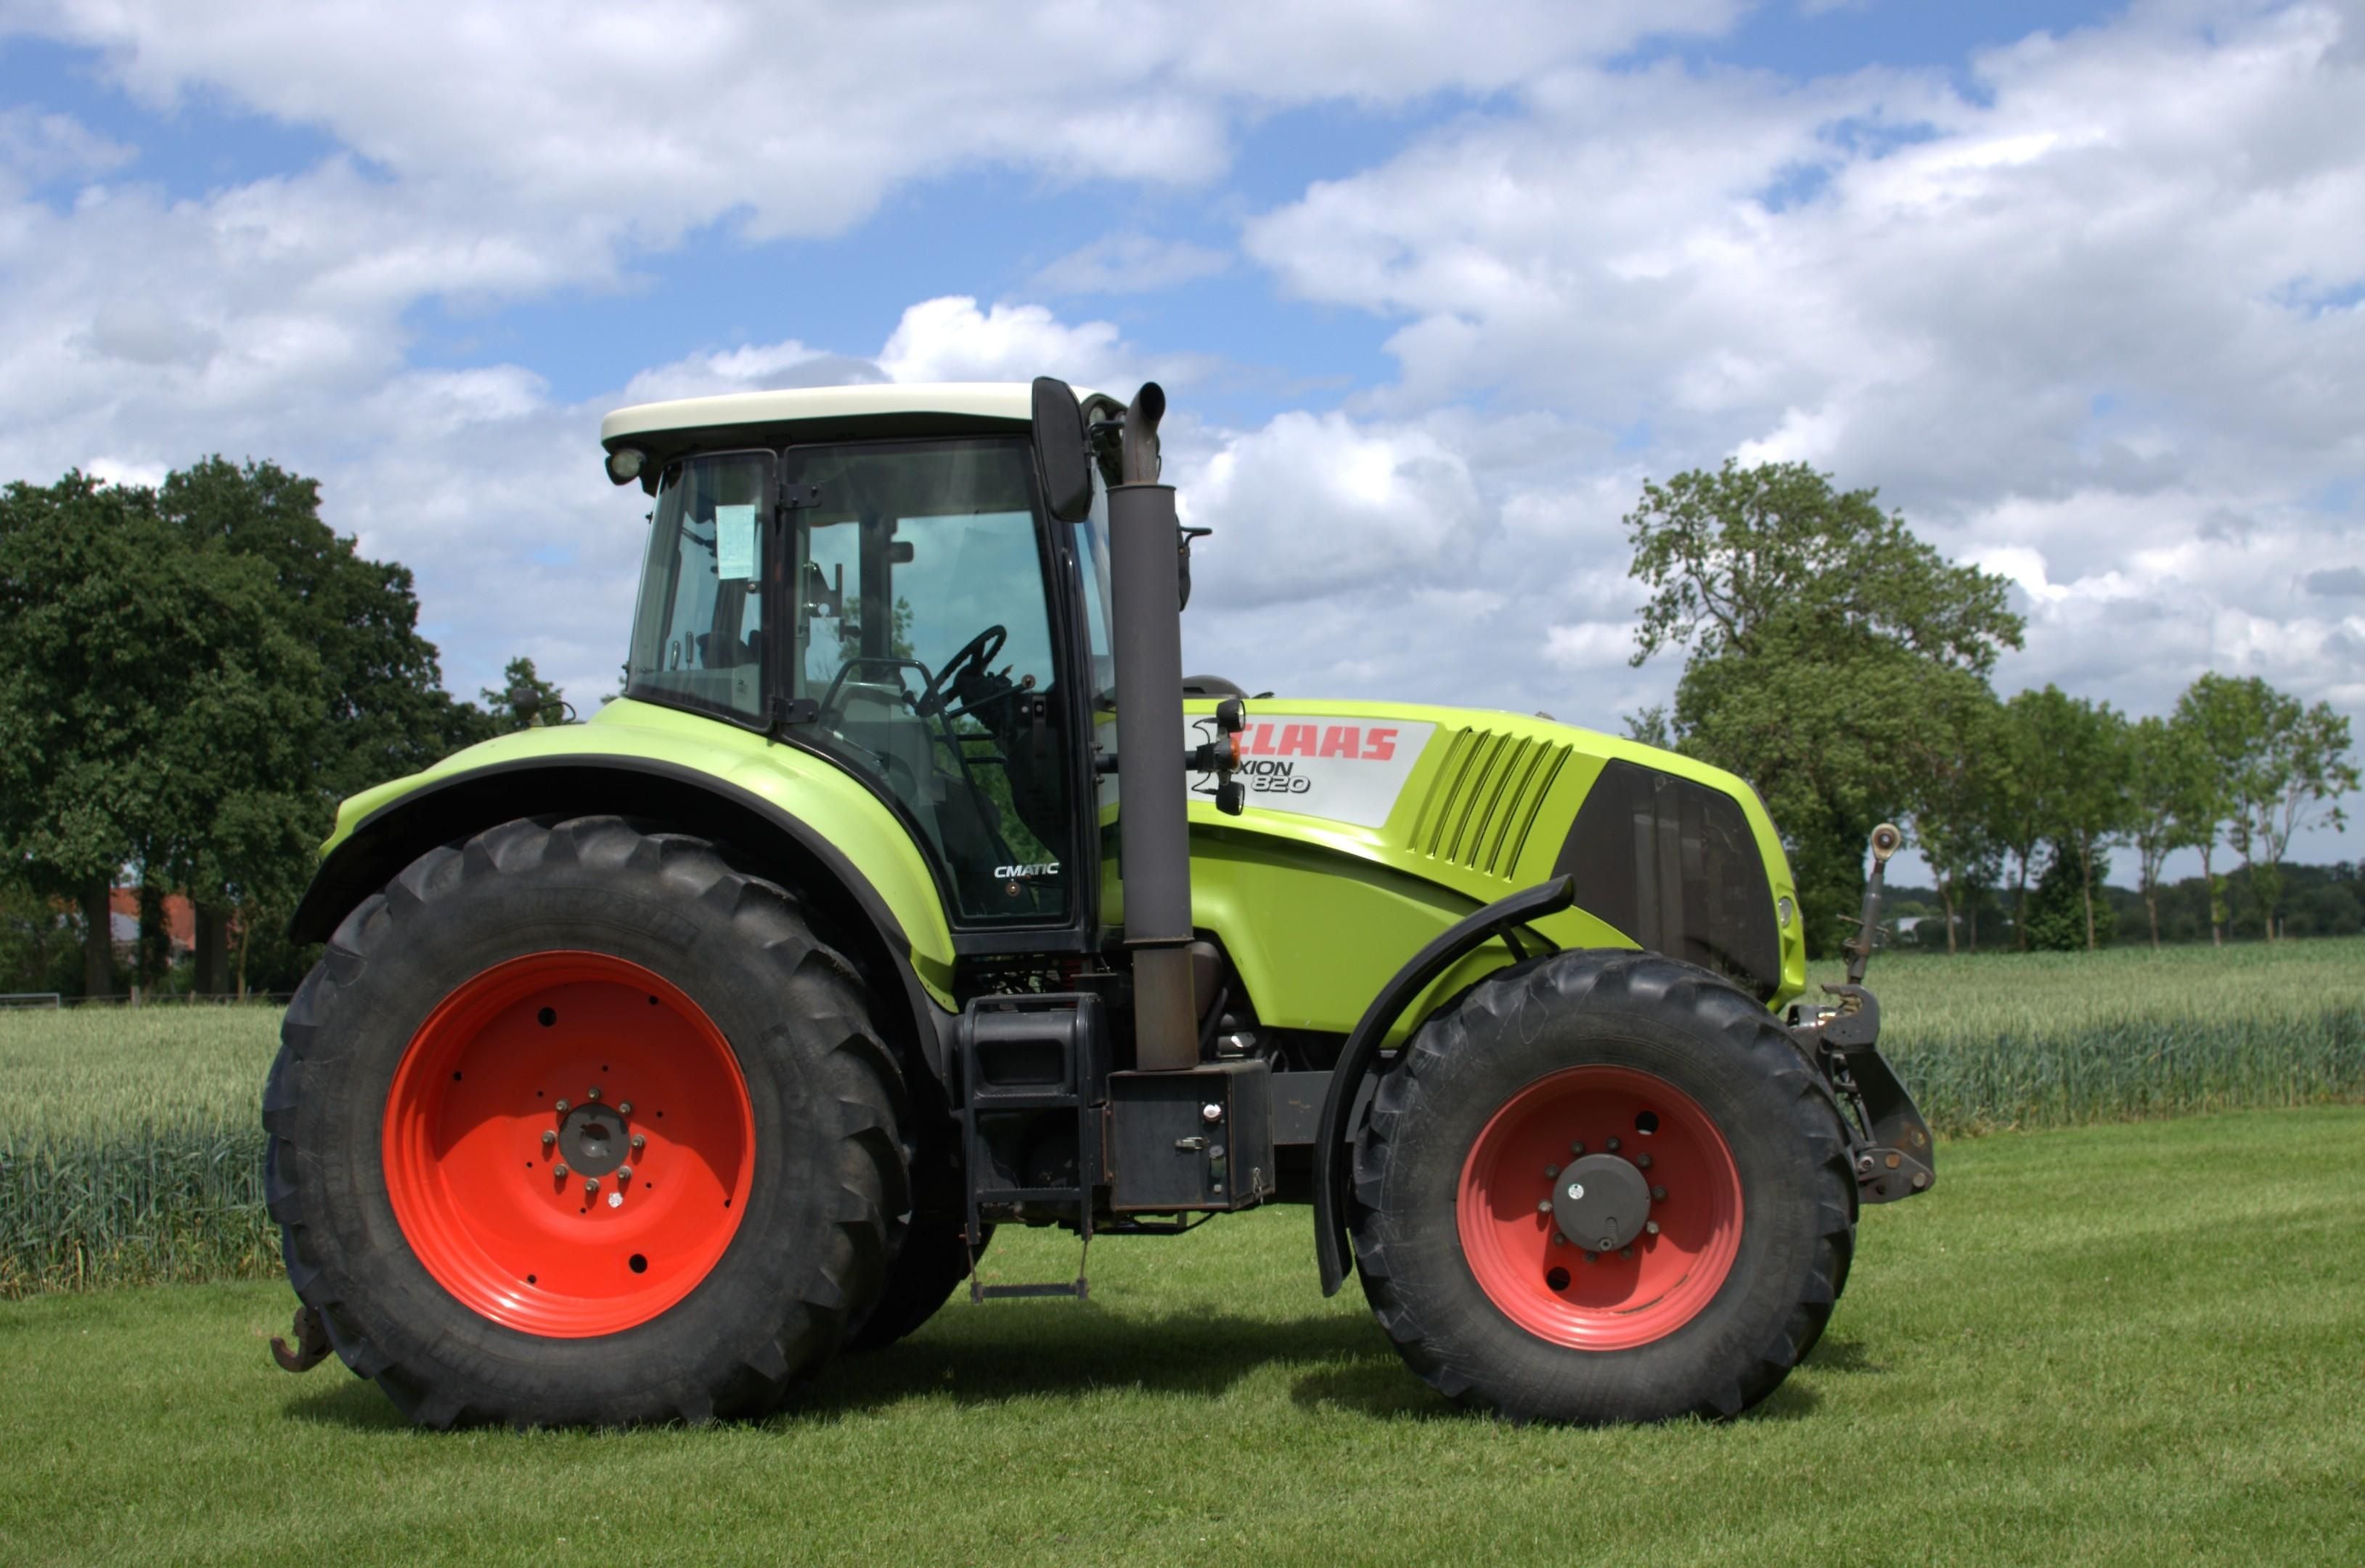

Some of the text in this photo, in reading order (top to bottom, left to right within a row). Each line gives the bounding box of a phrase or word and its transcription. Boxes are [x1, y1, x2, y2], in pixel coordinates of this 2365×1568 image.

[1235, 760, 1294, 776] XION
[1251, 775, 1311, 793] 820
[994, 862, 1059, 878] CMATIC
